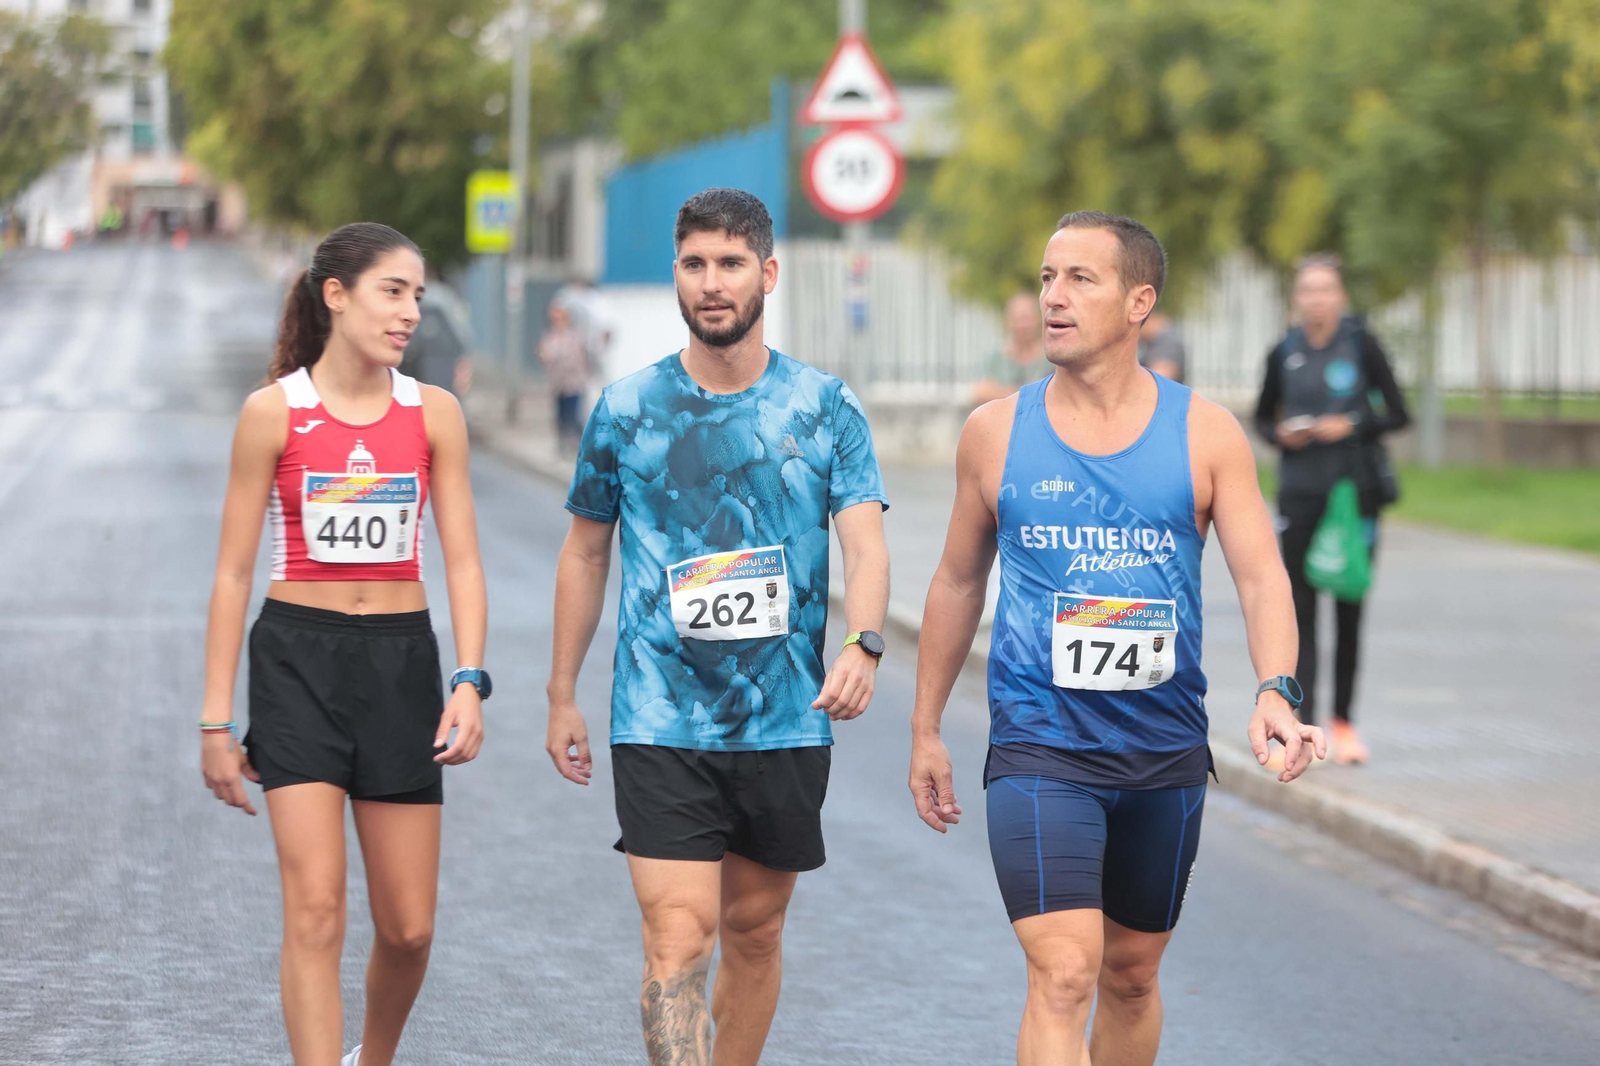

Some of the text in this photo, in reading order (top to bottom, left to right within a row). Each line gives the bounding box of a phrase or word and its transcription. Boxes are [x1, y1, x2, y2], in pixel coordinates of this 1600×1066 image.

[366, 483, 414, 492] POPULAR
[1041, 480, 1075, 492] GOBIK
[316, 516, 387, 549] 440
[1020, 525, 1176, 552] ESTUTIENDA
[678, 556, 777, 580] CARRERA POPULAR
[729, 568, 756, 578] SANTO
[758, 566, 782, 575] ANGEL
[1065, 551, 1174, 576] Atletismo
[686, 591, 758, 630] 262
[1064, 603, 1167, 619] CARRERA POPULAR
[1117, 619, 1147, 628] SANTO
[1066, 639, 1140, 677] 174
